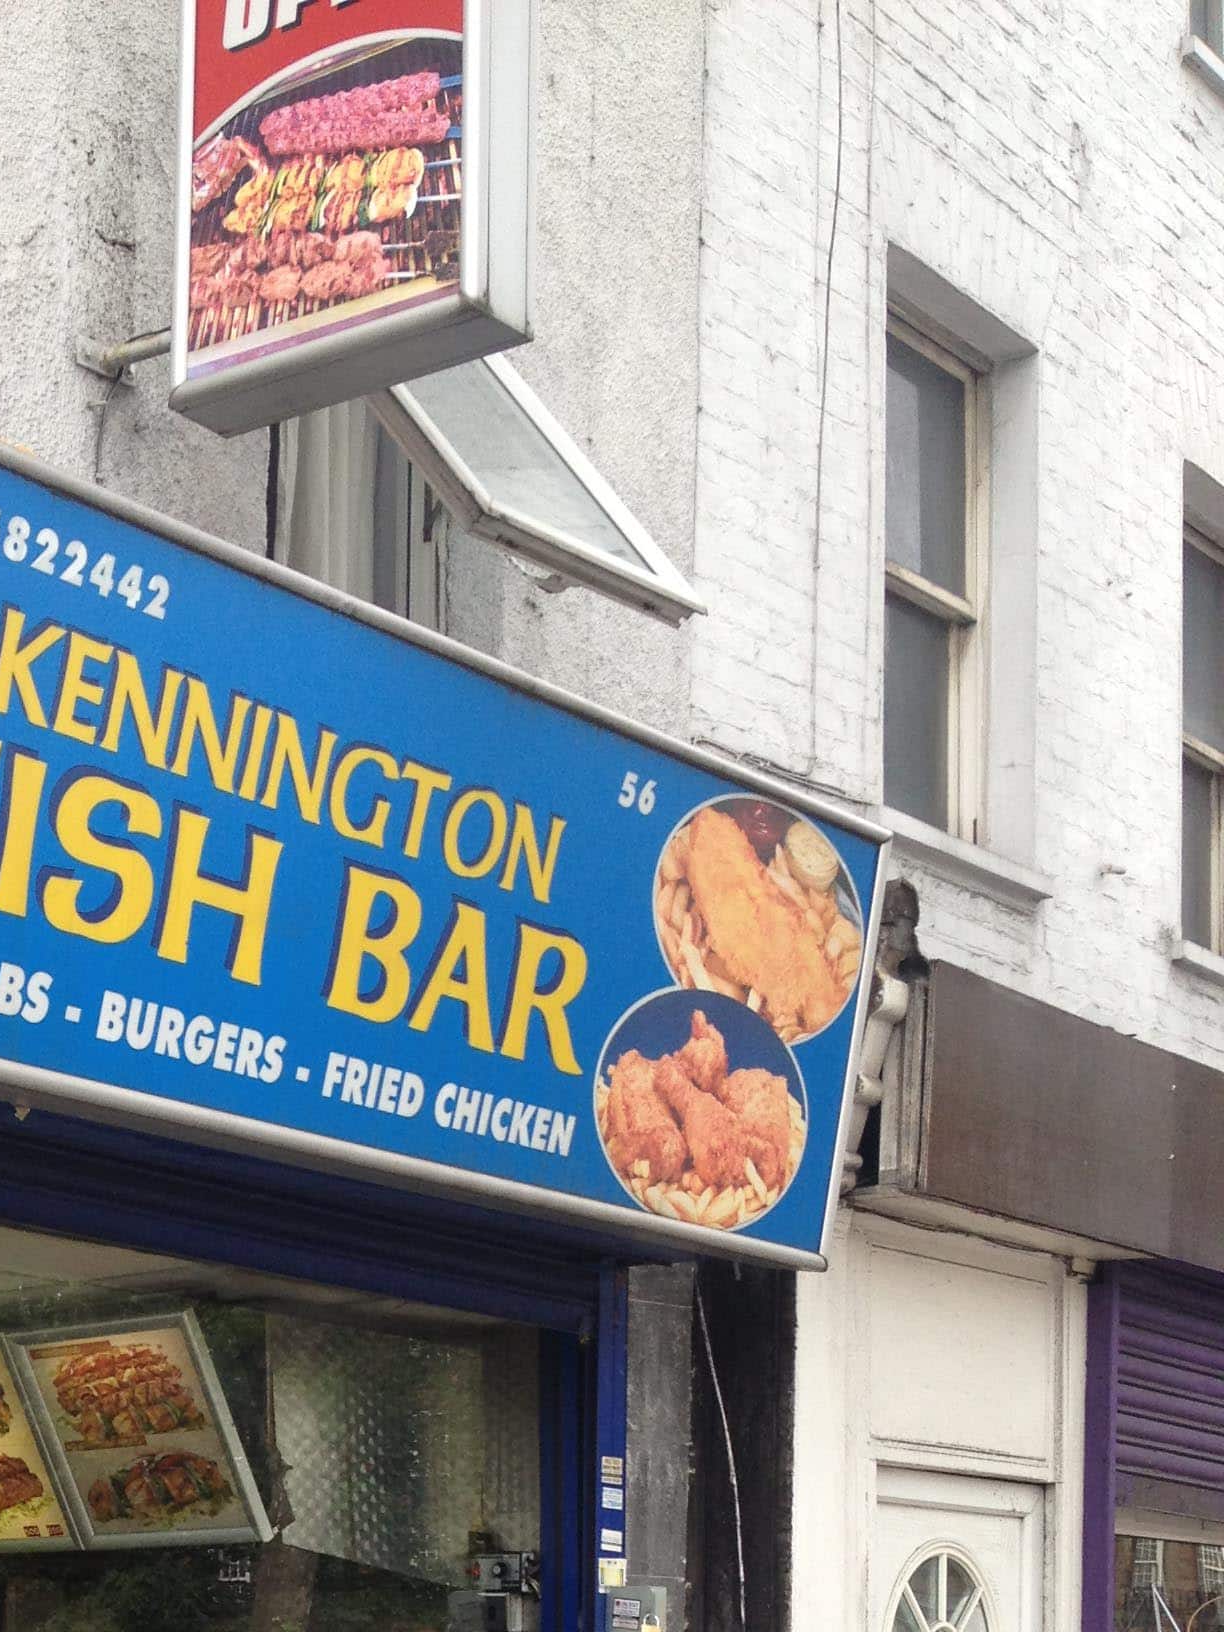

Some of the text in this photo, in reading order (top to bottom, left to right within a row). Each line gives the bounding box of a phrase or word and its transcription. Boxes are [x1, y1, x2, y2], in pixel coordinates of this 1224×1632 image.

[617, 770, 658, 816] 56
[324, 860, 589, 1075] BAR
[95, 991, 288, 1083] BURGERS
[321, 1052, 425, 1119] FRIED
[433, 1082, 576, 1157] CHICKEN
